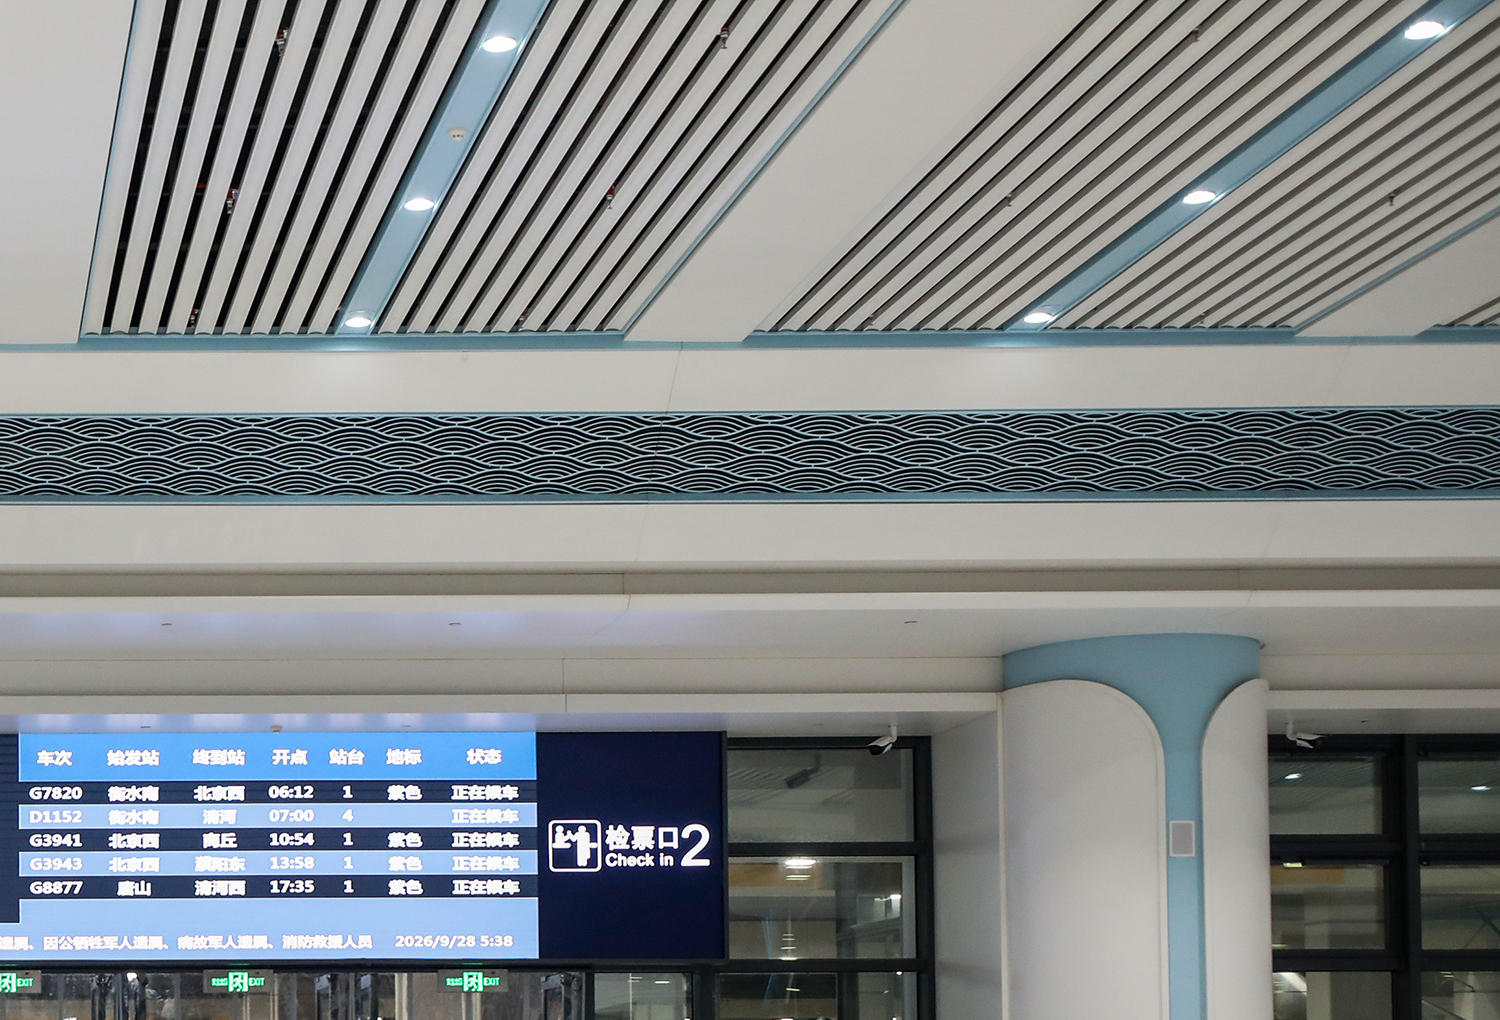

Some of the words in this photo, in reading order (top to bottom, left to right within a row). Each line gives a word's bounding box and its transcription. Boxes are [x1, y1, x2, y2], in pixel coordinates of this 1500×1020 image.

[36, 749, 73, 767] 车次
[106, 749, 160, 767] 始发站
[192, 748, 246, 766] 终到站
[271, 748, 308, 766] 开点
[328, 748, 366, 766] 站台
[386, 748, 423, 765] 地标
[466, 748, 502, 765] 状态
[29, 786, 83, 800] G7820
[193, 785, 246, 802] 北京西
[268, 785, 314, 799] 06:12
[342, 785, 354, 799] 1
[387, 784, 423, 801] 紫色
[450, 784, 520, 801] 正在候车
[29, 810, 82, 823] D1152
[202, 809, 237, 825] 清河
[269, 809, 315, 822] 07:00
[342, 809, 354, 822] 4
[451, 808, 520, 824] 正在候车
[29, 833, 83, 847] G3941
[108, 832, 160, 849] 北京西
[202, 831, 238, 849] 商丘
[269, 832, 315, 846] 10:54
[343, 832, 354, 846] 1
[387, 831, 423, 848] 紫色
[451, 831, 520, 848] 正在候车
[605, 824, 679, 851] 检票口
[680, 823, 711, 867] 2
[29, 857, 83, 871] G3943
[108, 856, 160, 873] 北京西
[270, 856, 315, 869] 13:58
[343, 856, 354, 869] 1
[388, 855, 423, 871] 紫色
[452, 855, 520, 871] 正在候车
[605, 853, 655, 867] Check
[659, 853, 674, 867] in
[29, 880, 84, 895] G8877
[116, 880, 152, 897] 唐山
[194, 879, 247, 896] 清河西
[270, 879, 315, 894] 17:35
[343, 879, 355, 893] 1
[388, 879, 424, 895] 紫色
[451, 879, 521, 895] 正在候车
[395, 935, 477, 949] 2026/9/28
[480, 935, 514, 947] 5:38
[19, 978, 34, 988] EXIT
[251, 977, 266, 987] EXIT
[486, 977, 501, 987] EXIT
